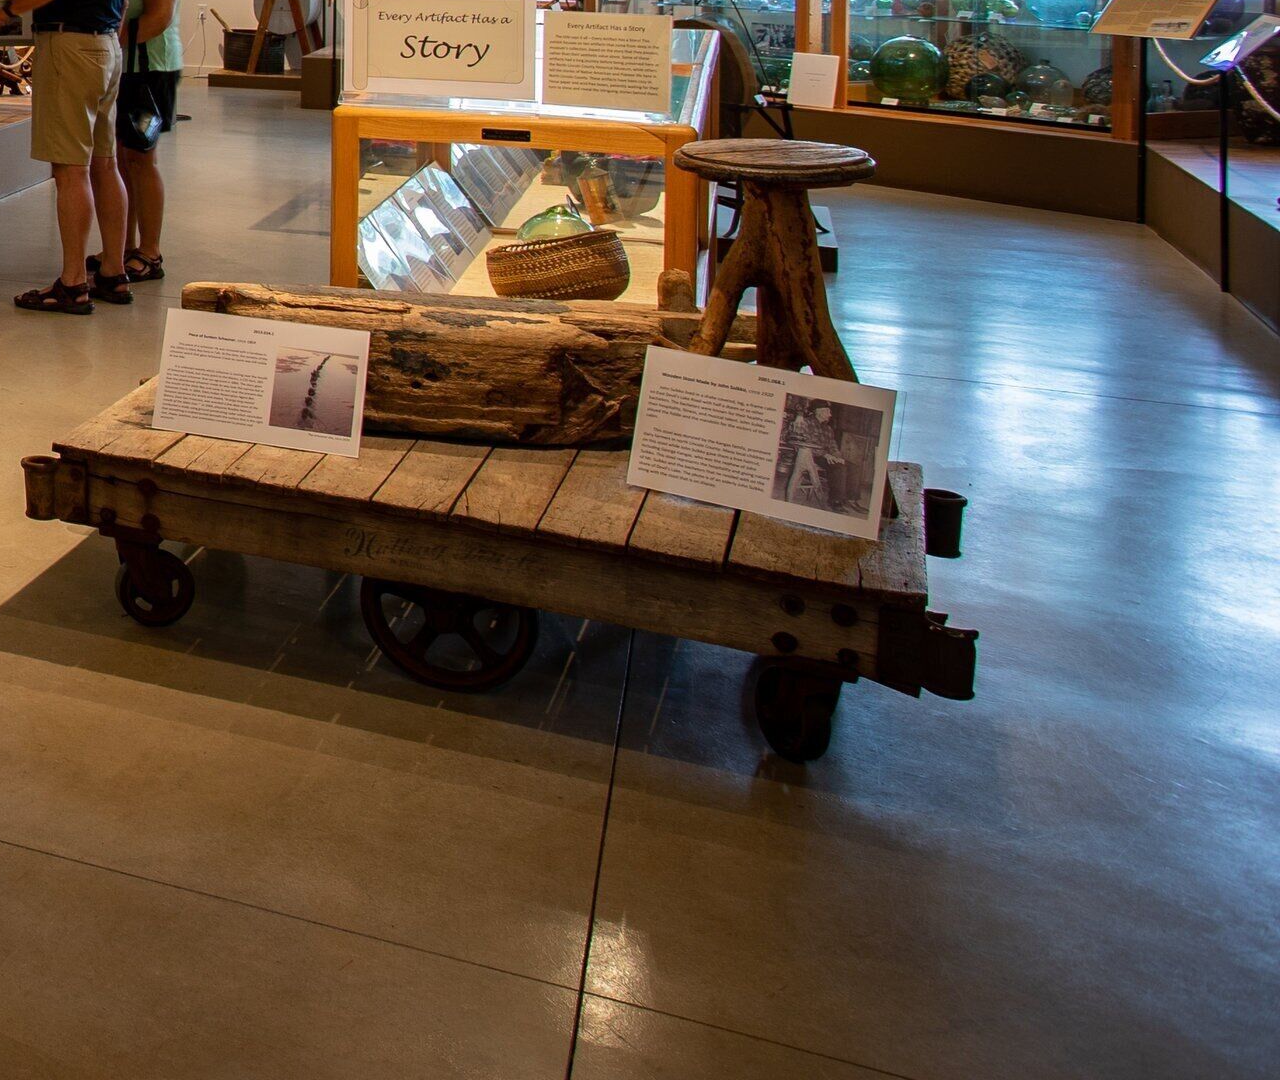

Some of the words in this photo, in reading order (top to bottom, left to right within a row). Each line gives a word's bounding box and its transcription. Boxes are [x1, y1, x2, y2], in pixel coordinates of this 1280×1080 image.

[378, 12, 412, 23] Every
[416, 12, 469, 24] Artifact
[471, 14, 499, 24] Has
[400, 35, 490, 67] Story
